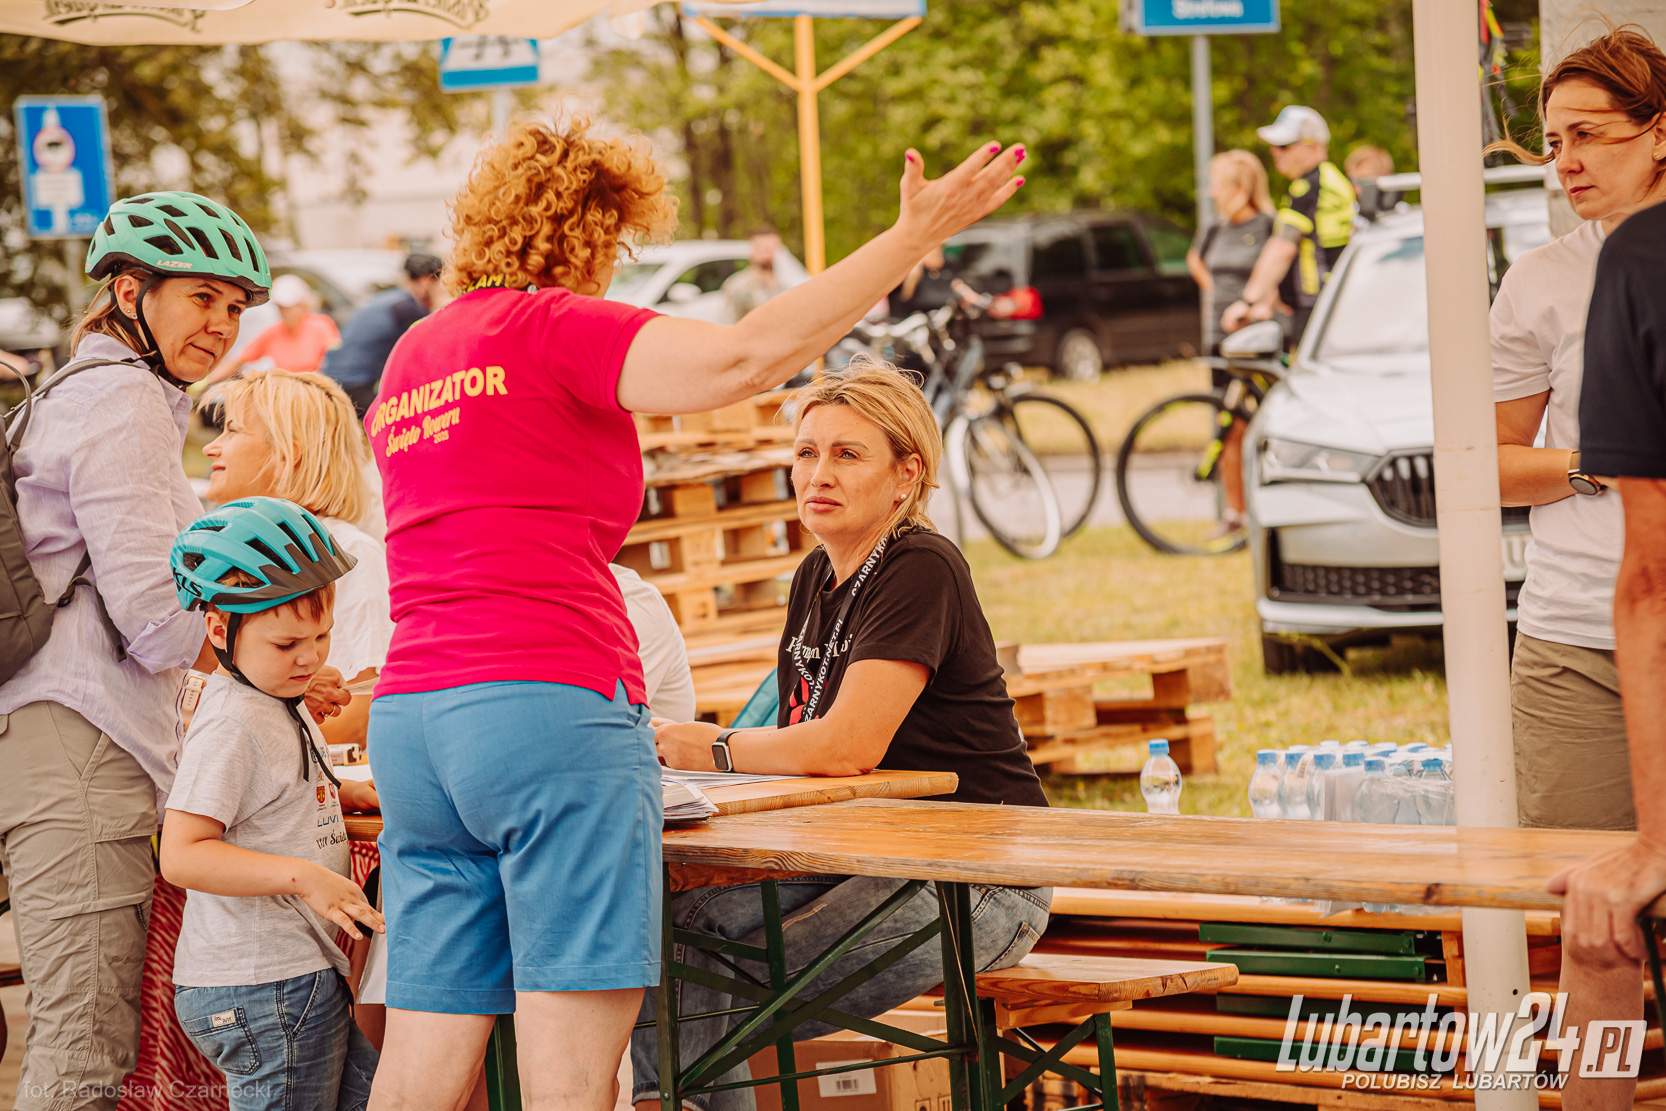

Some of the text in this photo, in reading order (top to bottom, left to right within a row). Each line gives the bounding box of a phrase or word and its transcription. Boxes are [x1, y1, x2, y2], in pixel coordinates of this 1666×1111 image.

[156, 259, 193, 269] LAZER
[371, 365, 508, 437] ORGANIZATOR
[386, 425, 421, 457] Święto
[173, 567, 203, 598] KLS
